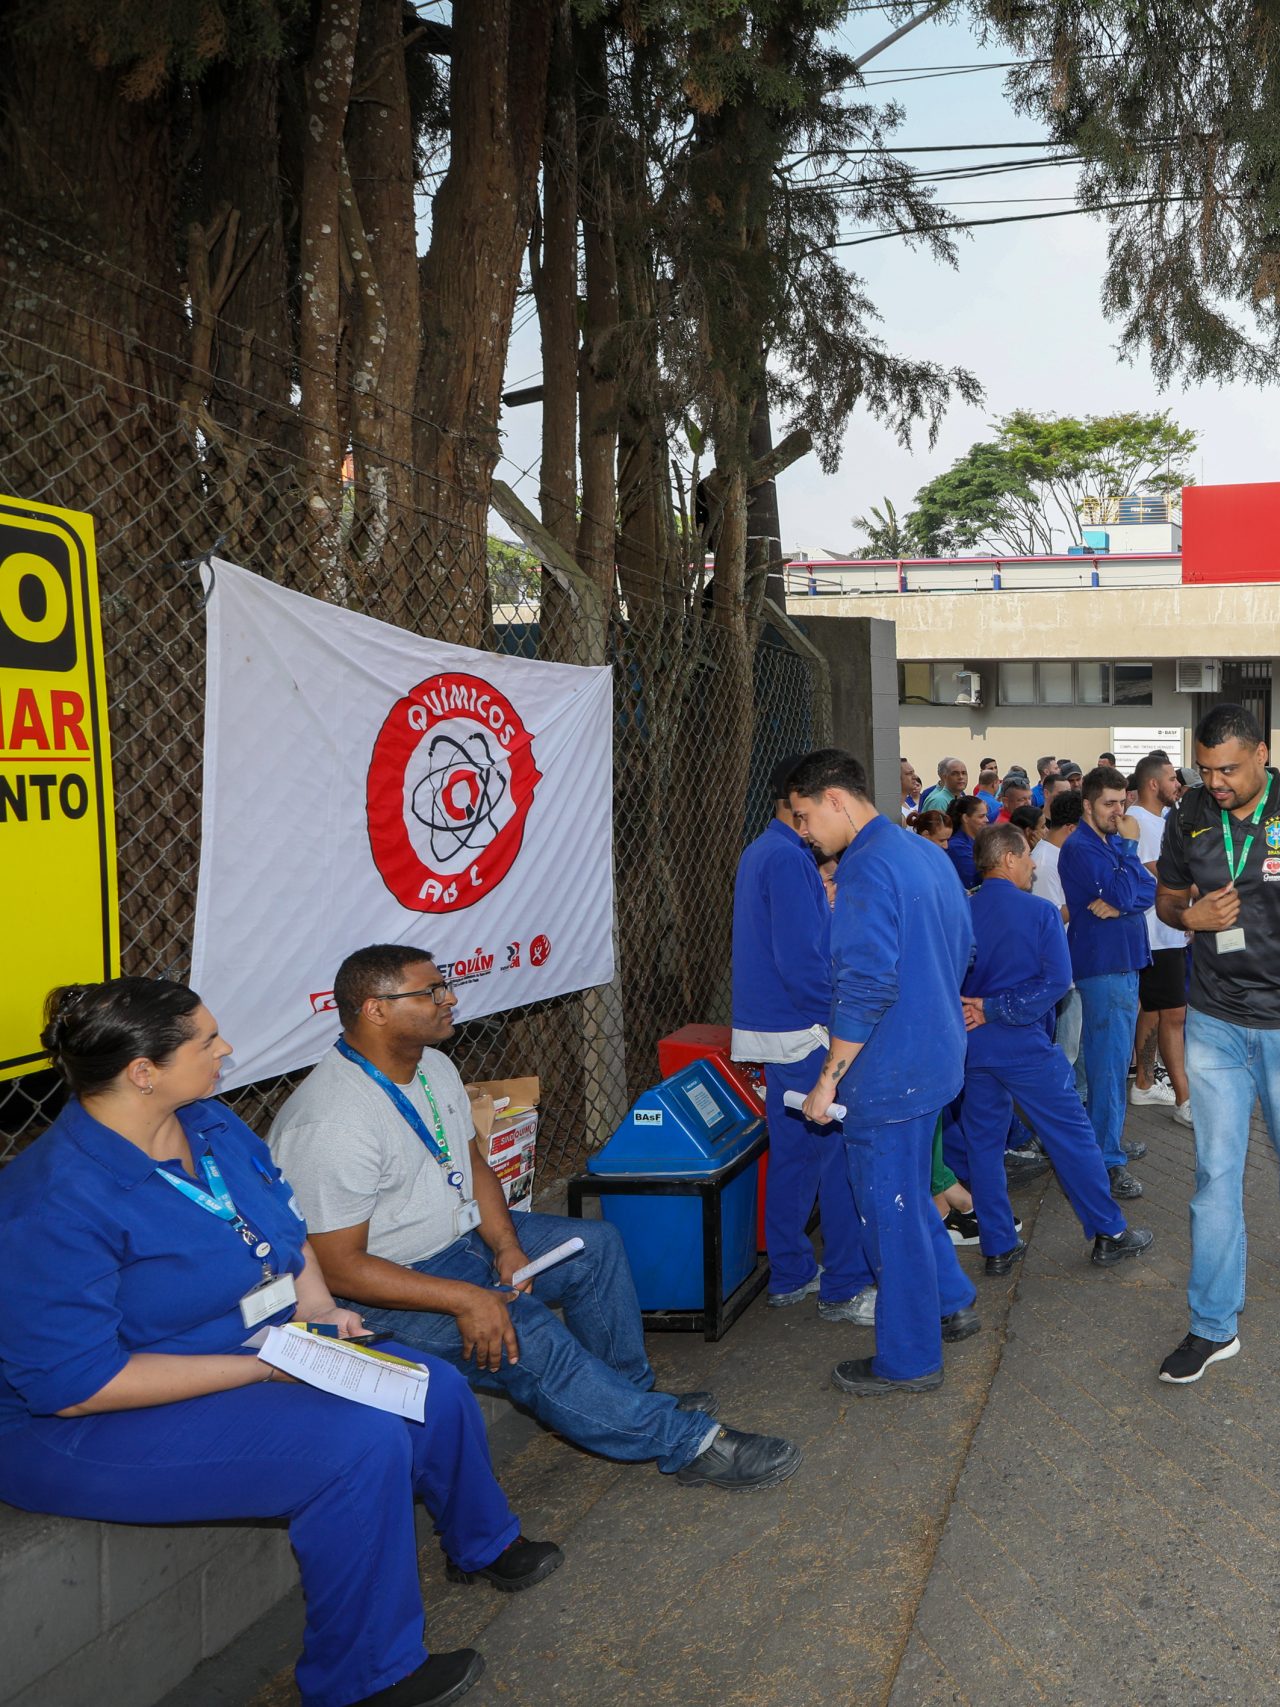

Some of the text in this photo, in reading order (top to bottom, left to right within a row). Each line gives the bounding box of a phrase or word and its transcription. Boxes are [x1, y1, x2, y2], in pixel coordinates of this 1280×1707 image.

[0, 687, 90, 751] AR
[408, 677, 515, 746] QUÍMICOS
[437, 951, 495, 978] ETQUIM
